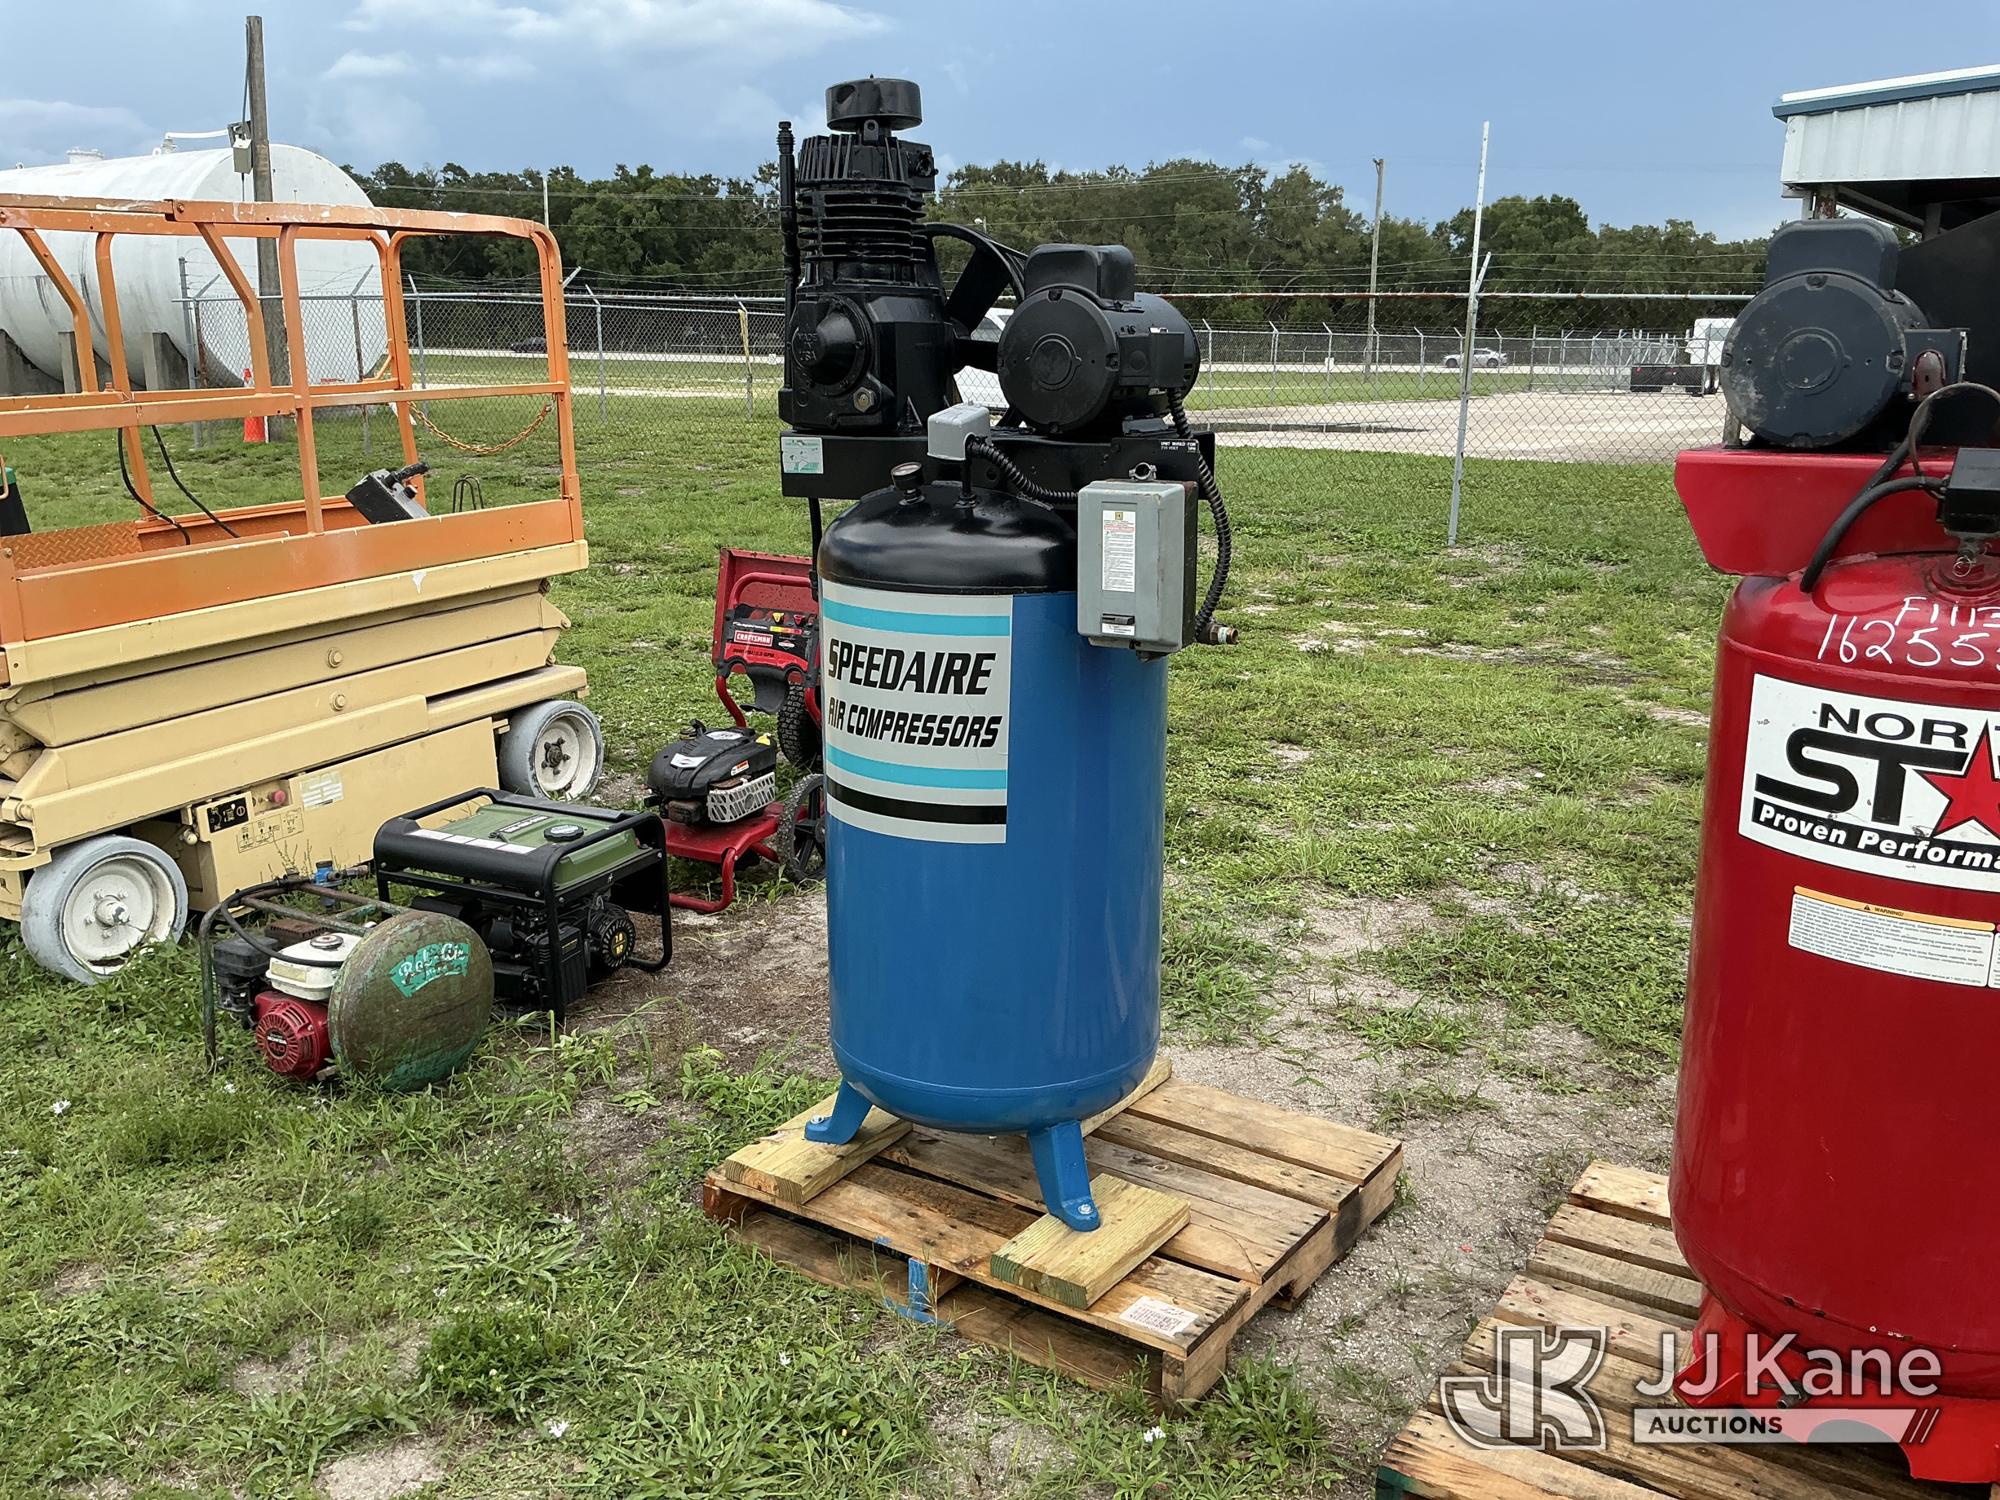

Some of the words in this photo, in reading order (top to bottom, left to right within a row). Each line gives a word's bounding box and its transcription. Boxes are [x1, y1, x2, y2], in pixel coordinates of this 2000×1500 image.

[736, 631, 771, 644] CRAFTSMAN
[1817, 613, 2000, 671] 16255
[828, 638, 996, 696] SPEEDAIRE
[828, 696, 847, 731] AIR
[847, 704, 1003, 748] COMPRESSORS
[1818, 702, 2000, 749] NOR
[1759, 803, 1848, 845] Proven
[1874, 906, 1905, 917] WARNING!
